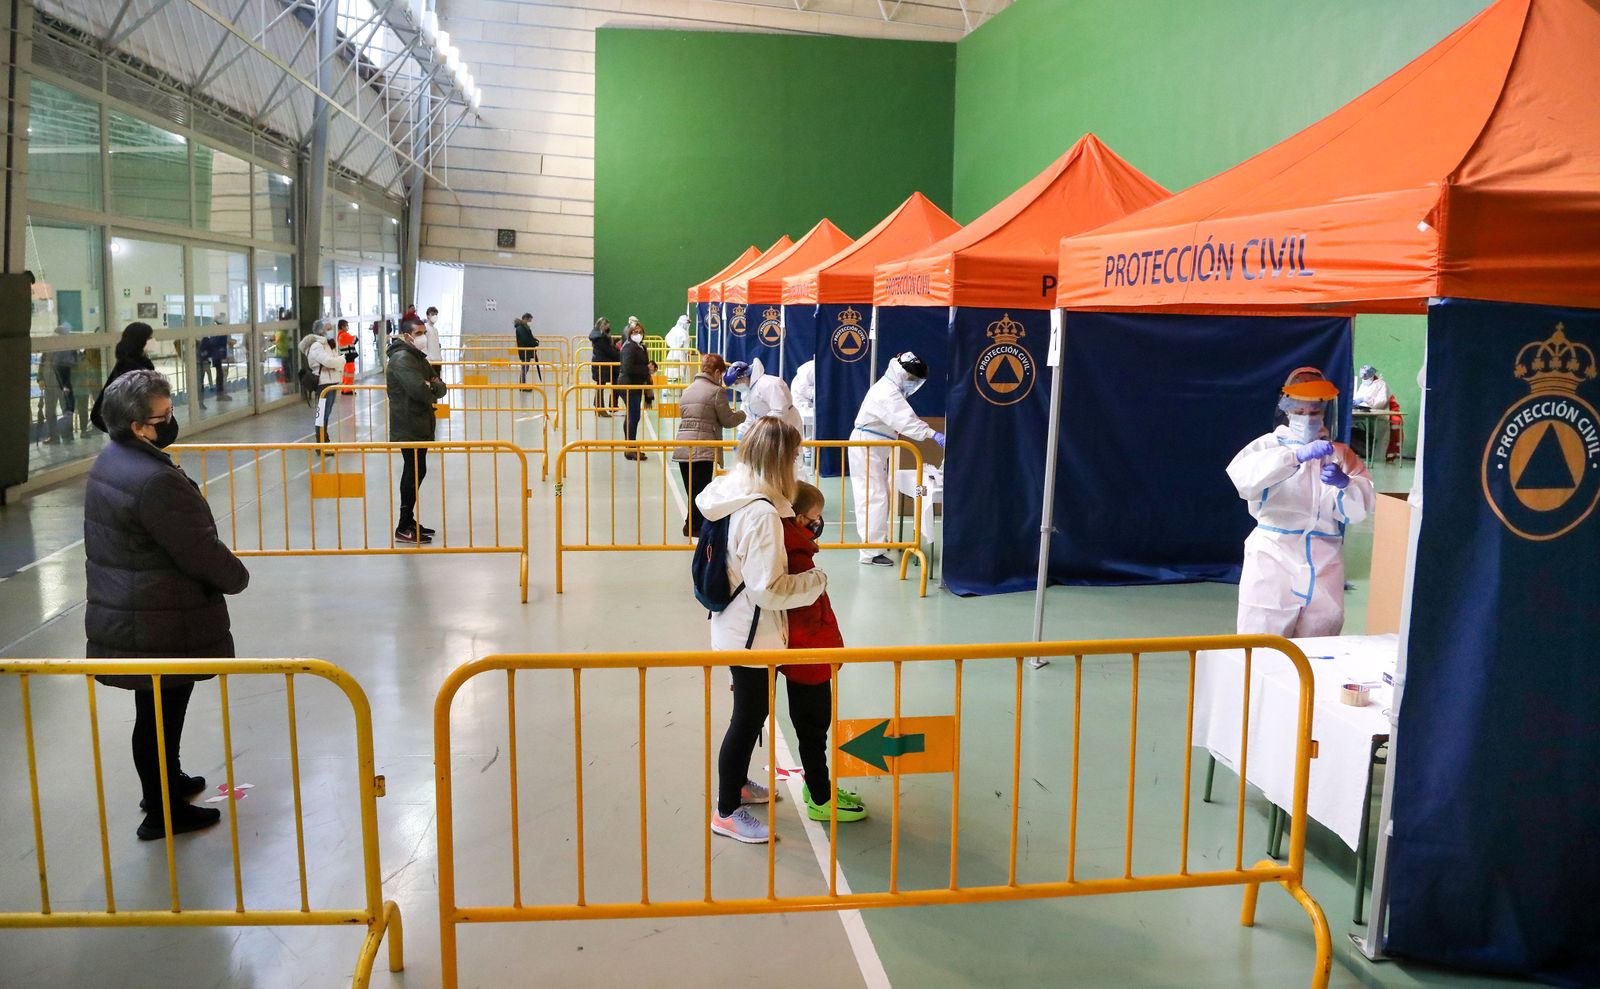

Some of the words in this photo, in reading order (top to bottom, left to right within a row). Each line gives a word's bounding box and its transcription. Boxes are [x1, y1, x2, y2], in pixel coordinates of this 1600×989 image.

[1104, 235, 1235, 288] PROTECCIÓN
[1241, 233, 1315, 280] CIVIL
[980, 346, 1019, 371] PROTECCIÓN
[1018, 352, 1030, 371] CIVIL
[1496, 400, 1580, 458] PROTECCIÓN
[1577, 417, 1600, 459] CIVIL
